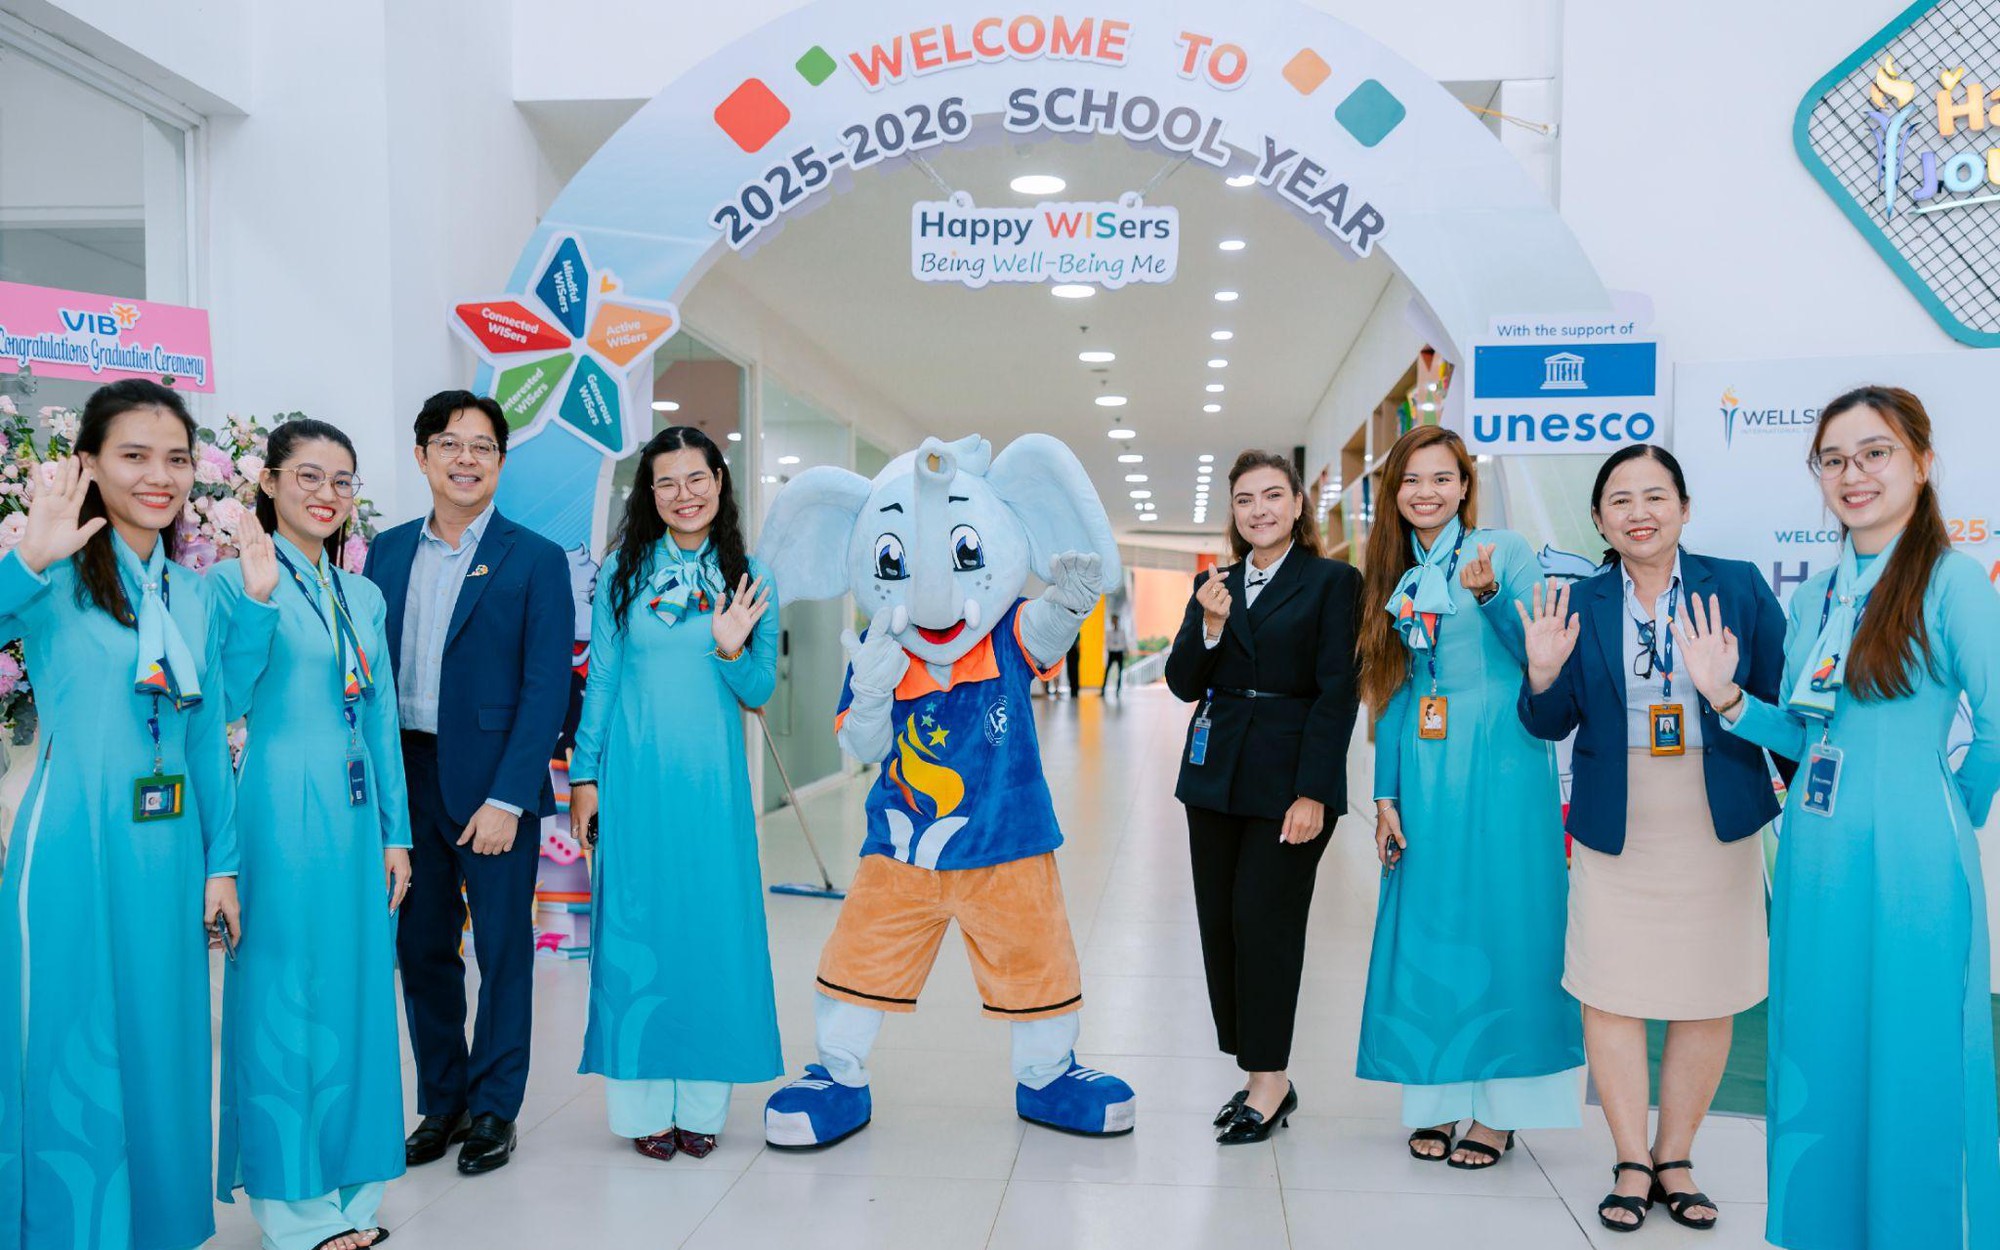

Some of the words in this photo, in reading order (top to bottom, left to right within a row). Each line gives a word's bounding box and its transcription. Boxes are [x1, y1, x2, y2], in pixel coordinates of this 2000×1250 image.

[849, 15, 1130, 86] WELCOME
[1179, 31, 1248, 84] TO
[714, 97, 967, 244] 2025-2026
[1009, 87, 1226, 161] SCHOOL
[1259, 135, 1385, 251] YEAR
[920, 211, 1033, 245] Happy
[1045, 211, 1170, 239] WISers
[920, 251, 985, 279] Being
[993, 251, 1125, 280] Well-Being
[1131, 254, 1167, 274] Me
[553, 271, 569, 313] WISers
[562, 259, 581, 304] Mindful
[61, 310, 118, 336] VIB
[481, 307, 540, 335] Connected
[488, 322, 528, 344] WISers
[606, 320, 641, 336] Active
[1497, 324, 1531, 337] With
[1535, 323, 1557, 336] the
[1561, 323, 1615, 338] support
[1620, 321, 1634, 335] of
[606, 332, 648, 349] WISers
[91, 338, 152, 371] Graduation
[154, 346, 204, 383] Ceremony
[514, 383, 548, 414] WISers
[579, 384, 600, 427] WISers
[587, 374, 613, 426] Generous
[1473, 412, 1655, 443] unesco
[1775, 530, 1840, 543] WELCO
